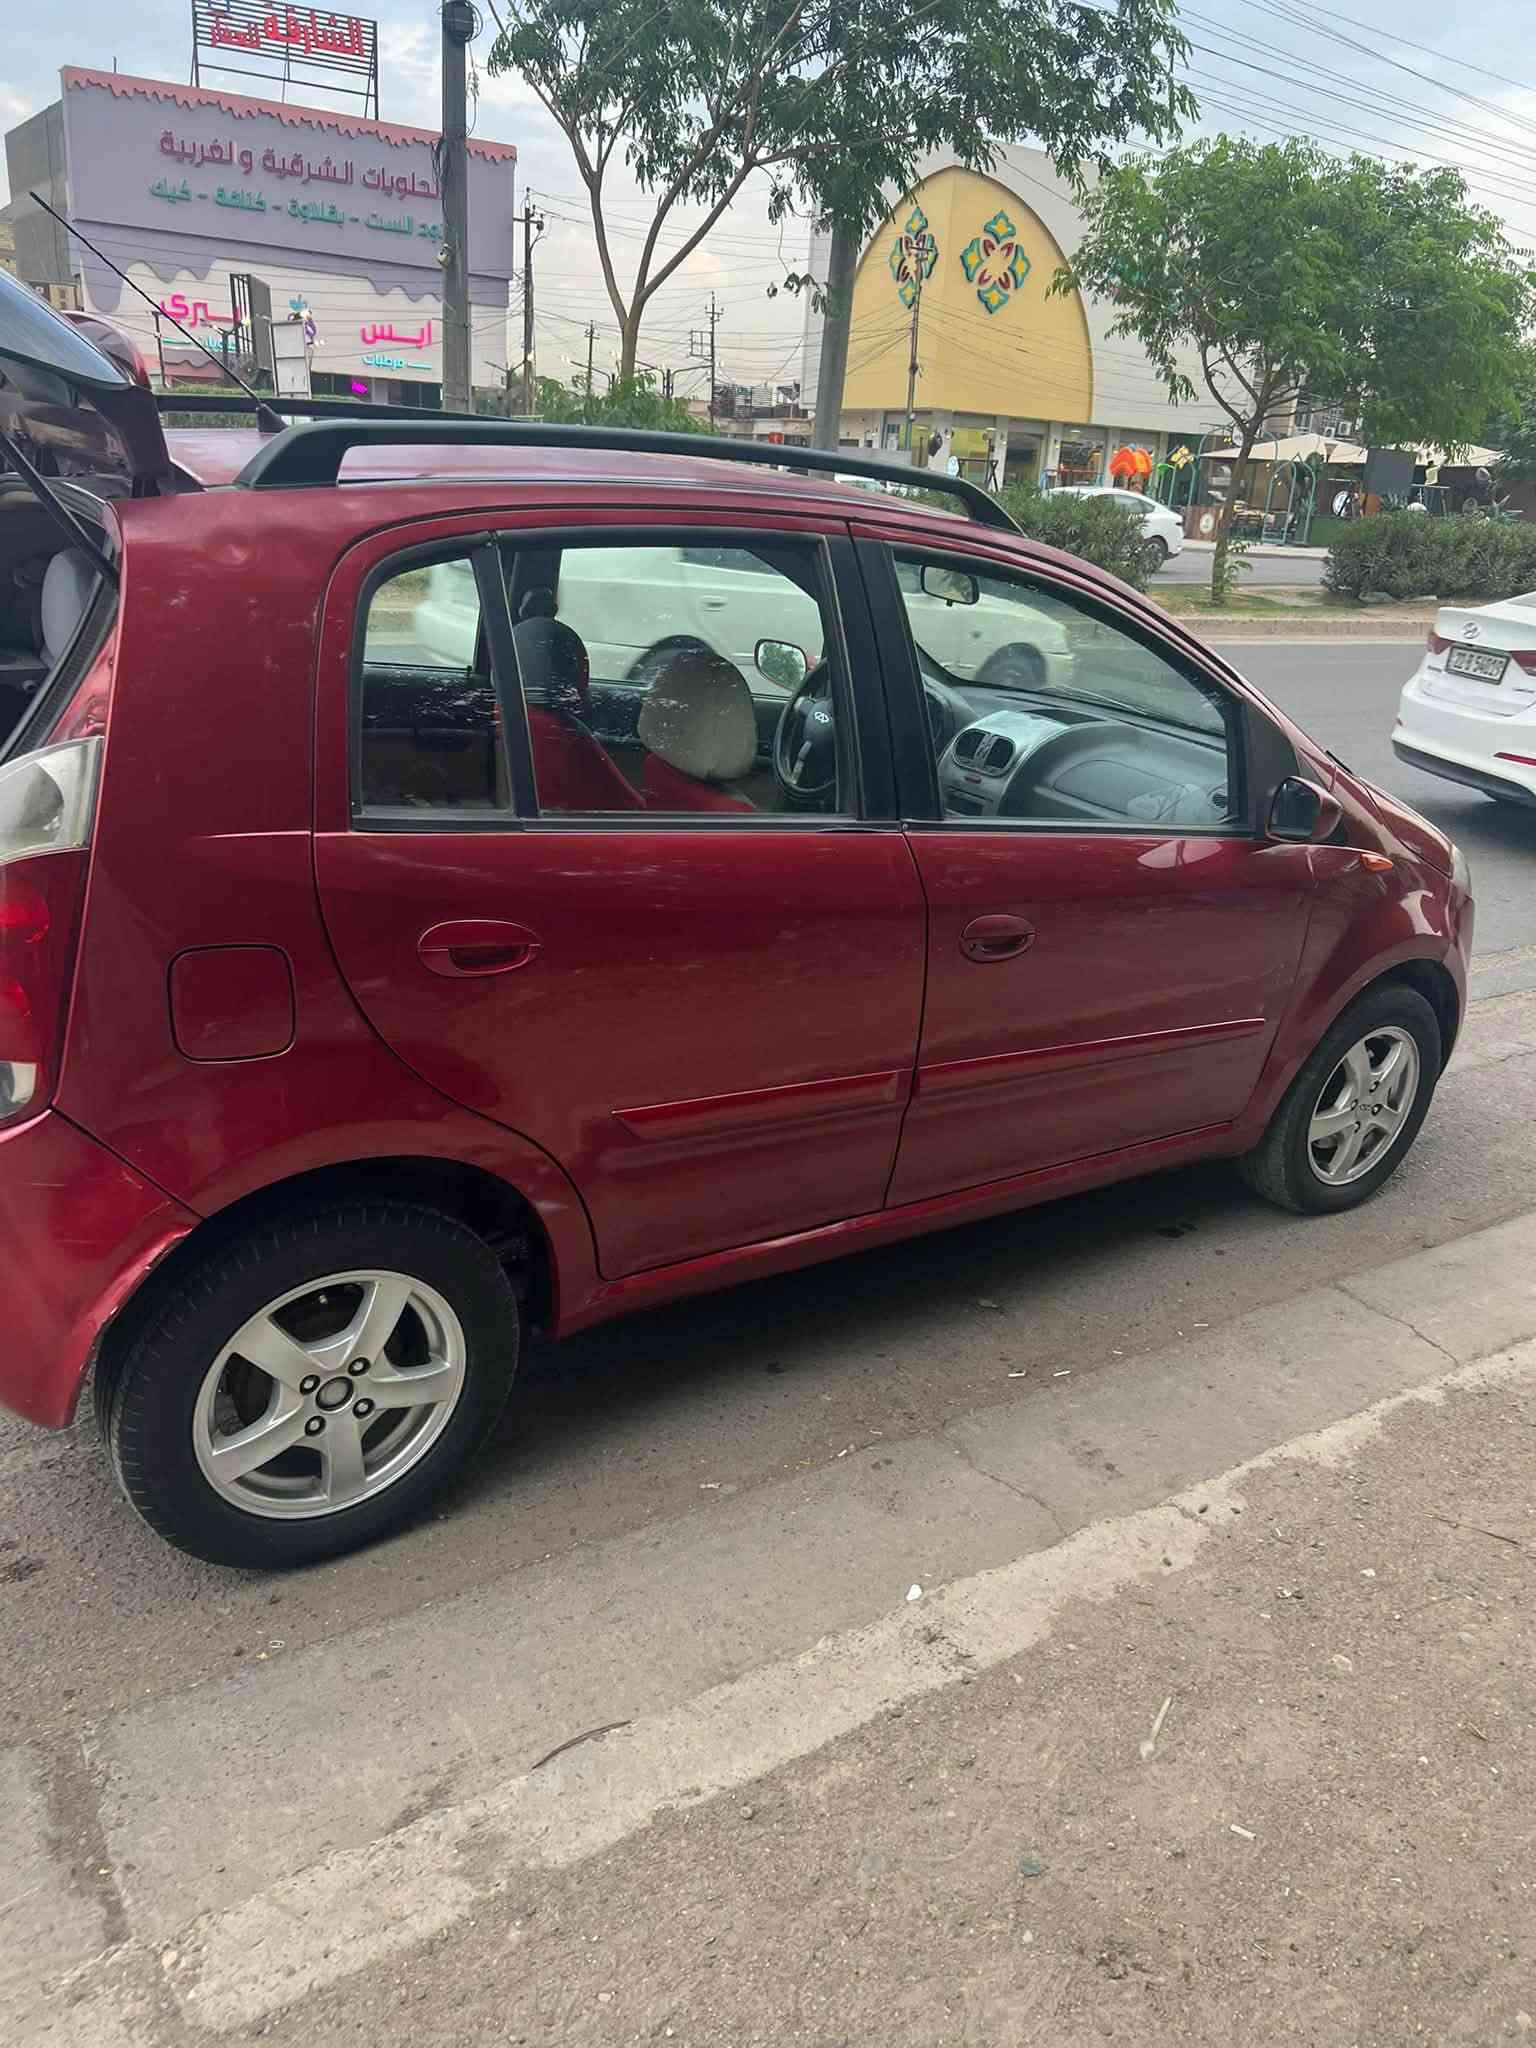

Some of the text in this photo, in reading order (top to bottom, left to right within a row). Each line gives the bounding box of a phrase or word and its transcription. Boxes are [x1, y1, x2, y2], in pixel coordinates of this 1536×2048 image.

[261, 147, 354, 185] الشرقية
[150, 176, 192, 204] كيك
[361, 167, 441, 201] لحلويات
